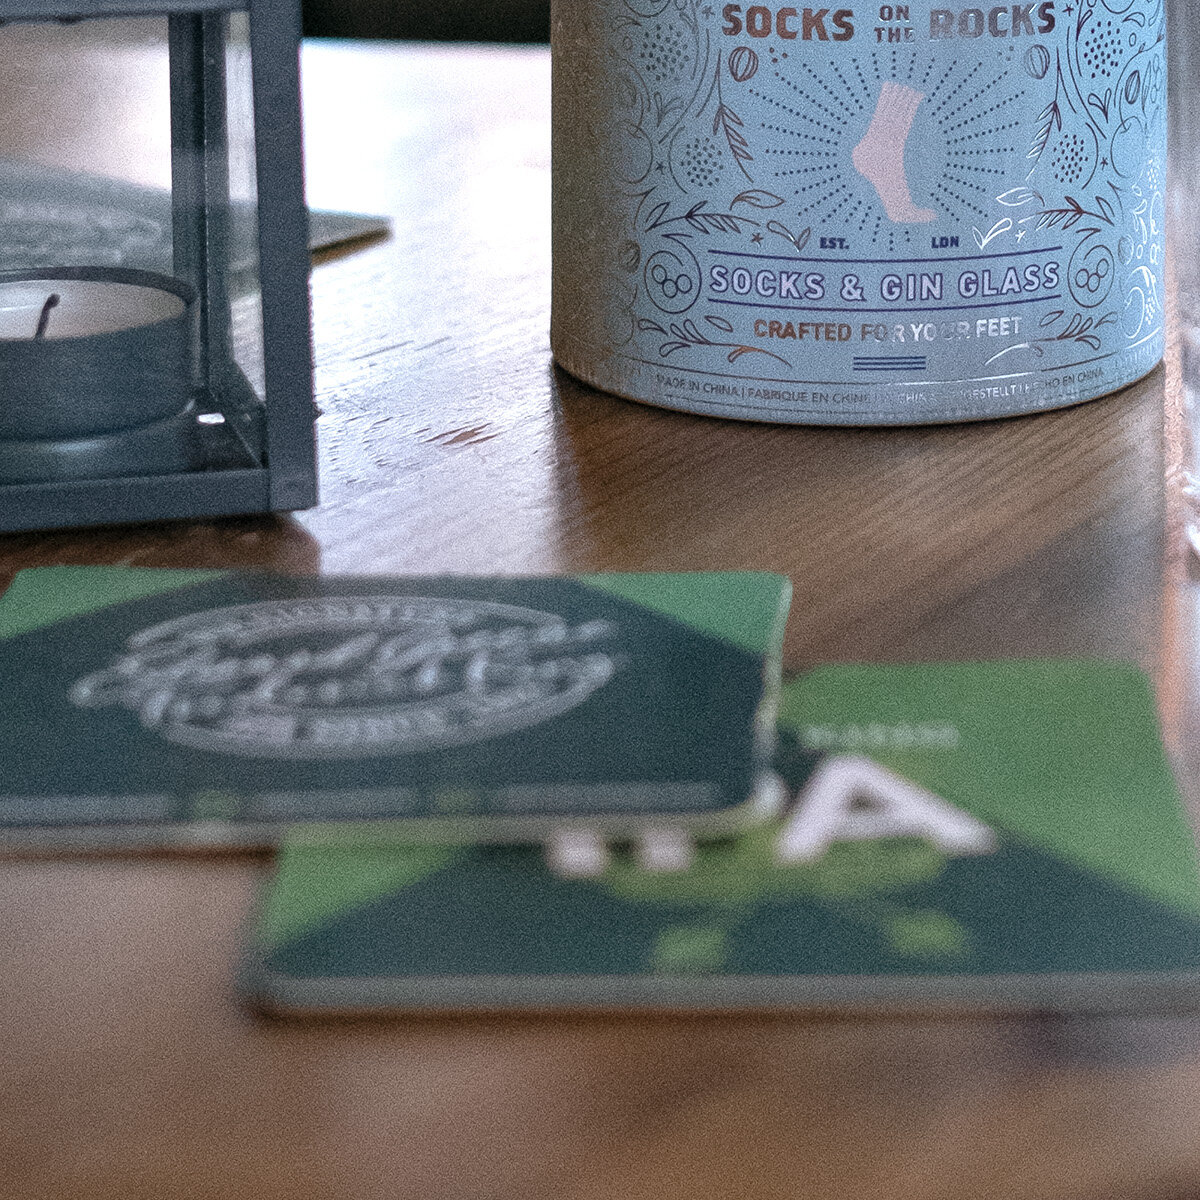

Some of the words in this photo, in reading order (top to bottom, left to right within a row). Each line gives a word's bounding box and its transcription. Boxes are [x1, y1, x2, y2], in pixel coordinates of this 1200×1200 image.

[721, 3, 855, 42] SOCKS
[878, 4, 910, 22] ON
[928, 1, 1055, 42] ROCKS
[873, 27, 916, 44] THE
[820, 236, 849, 250] EST.
[931, 236, 959, 249] LDN
[709, 265, 825, 299] SOCKS
[840, 275, 866, 300] &
[880, 273, 943, 300] GIN
[958, 262, 1060, 297] GLASS
[754, 319, 852, 342] CRAFTED
[860, 322, 906, 343] FOR
[975, 316, 1022, 338] FEET
[703, 382, 740, 397] CHINA
[749, 387, 809, 402] FABRIQUE
[812, 392, 829, 403] EN
